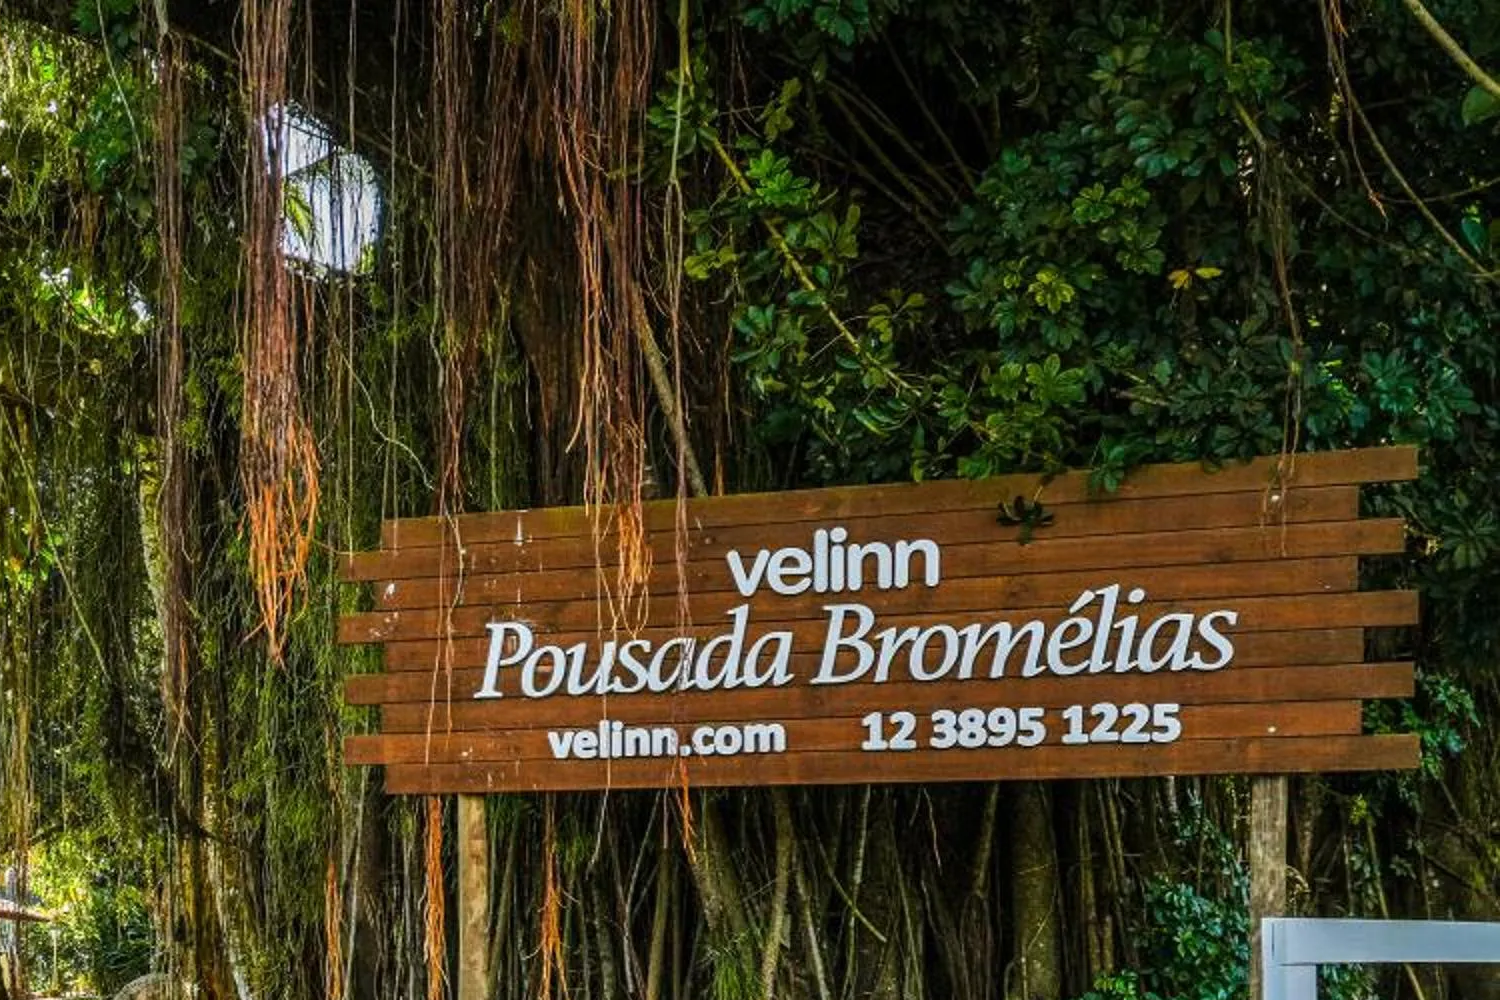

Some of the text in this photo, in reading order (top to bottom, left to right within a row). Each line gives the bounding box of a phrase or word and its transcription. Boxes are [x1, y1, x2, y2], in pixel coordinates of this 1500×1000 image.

[726, 526, 940, 597] velinn
[473, 583, 1238, 699] Pousada Bromélias
[547, 718, 786, 760] velinn.com
[861, 702, 1182, 751] 12 3895 1225
